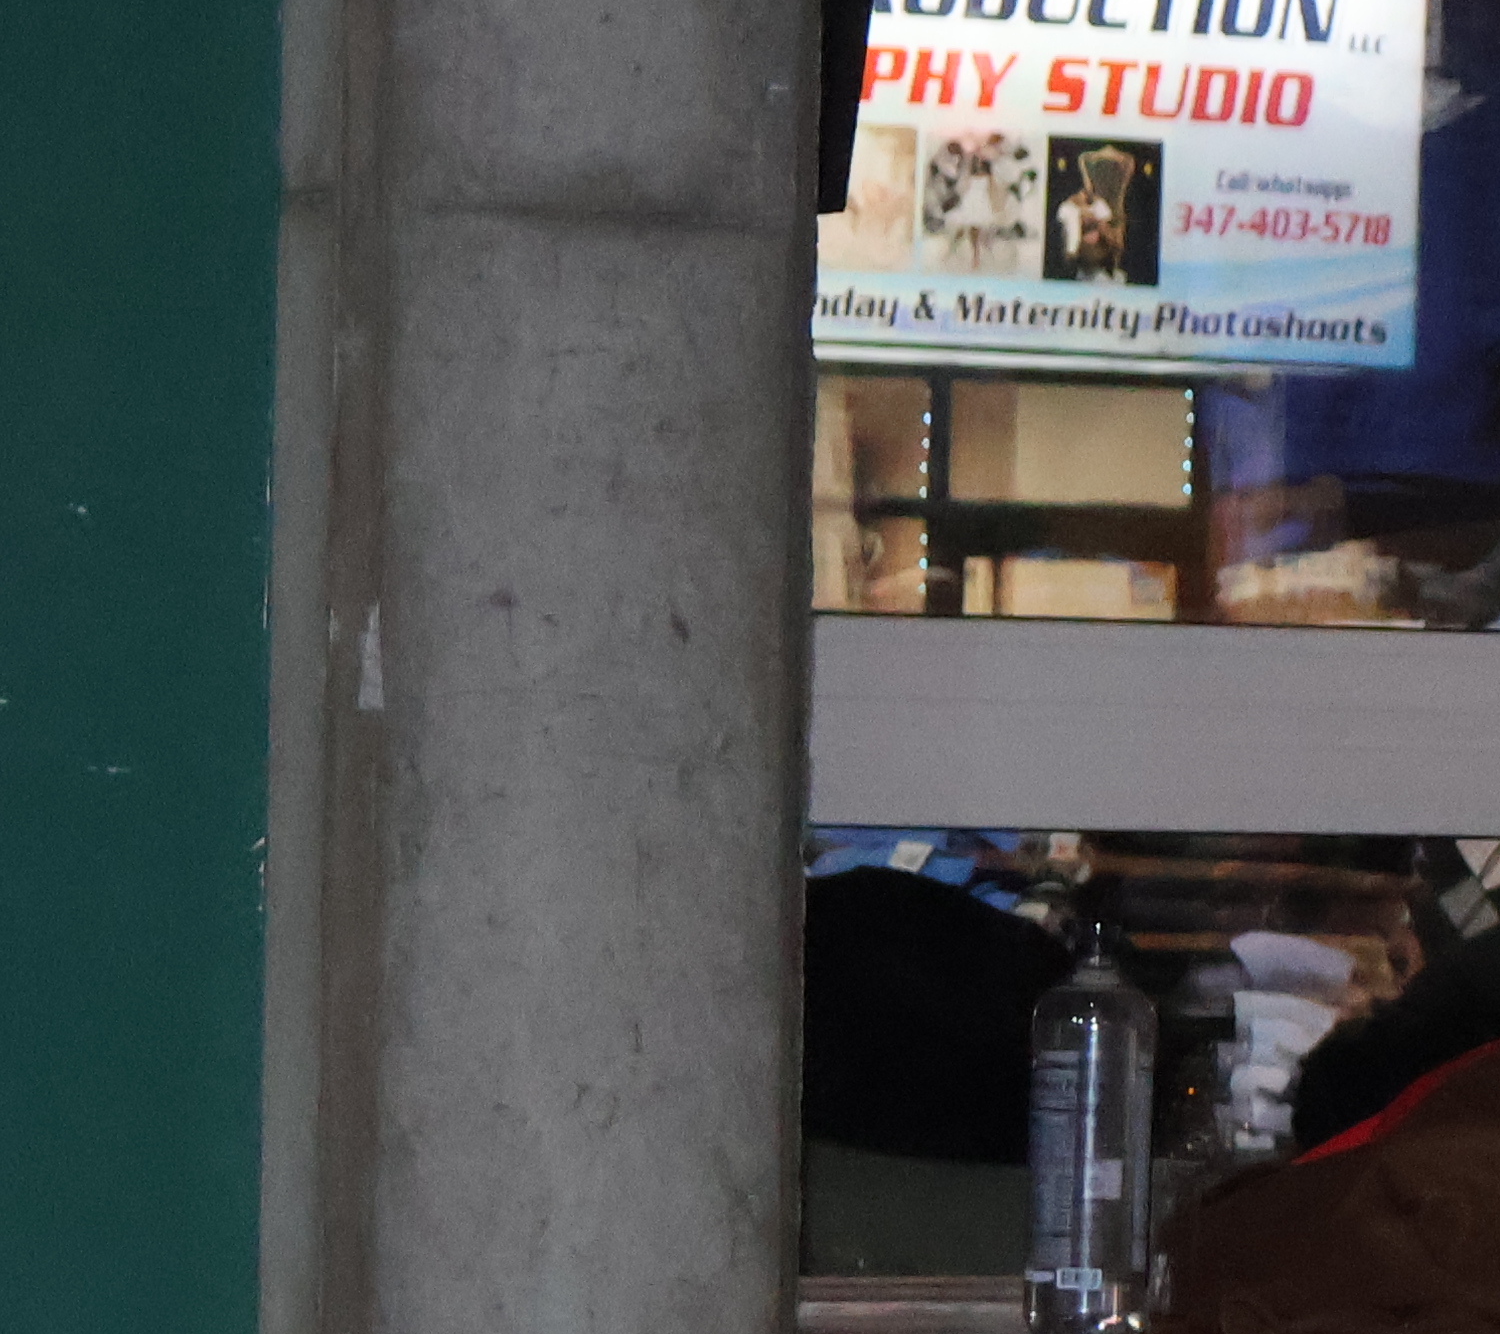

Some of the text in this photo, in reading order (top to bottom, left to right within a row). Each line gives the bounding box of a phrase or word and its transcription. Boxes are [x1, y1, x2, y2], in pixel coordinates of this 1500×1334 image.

[858, 44, 1315, 128] PHY STUDIO
[912, 289, 937, 322] &
[956, 290, 1140, 340] Maternity
[1152, 303, 1388, 347] Photoshoots
